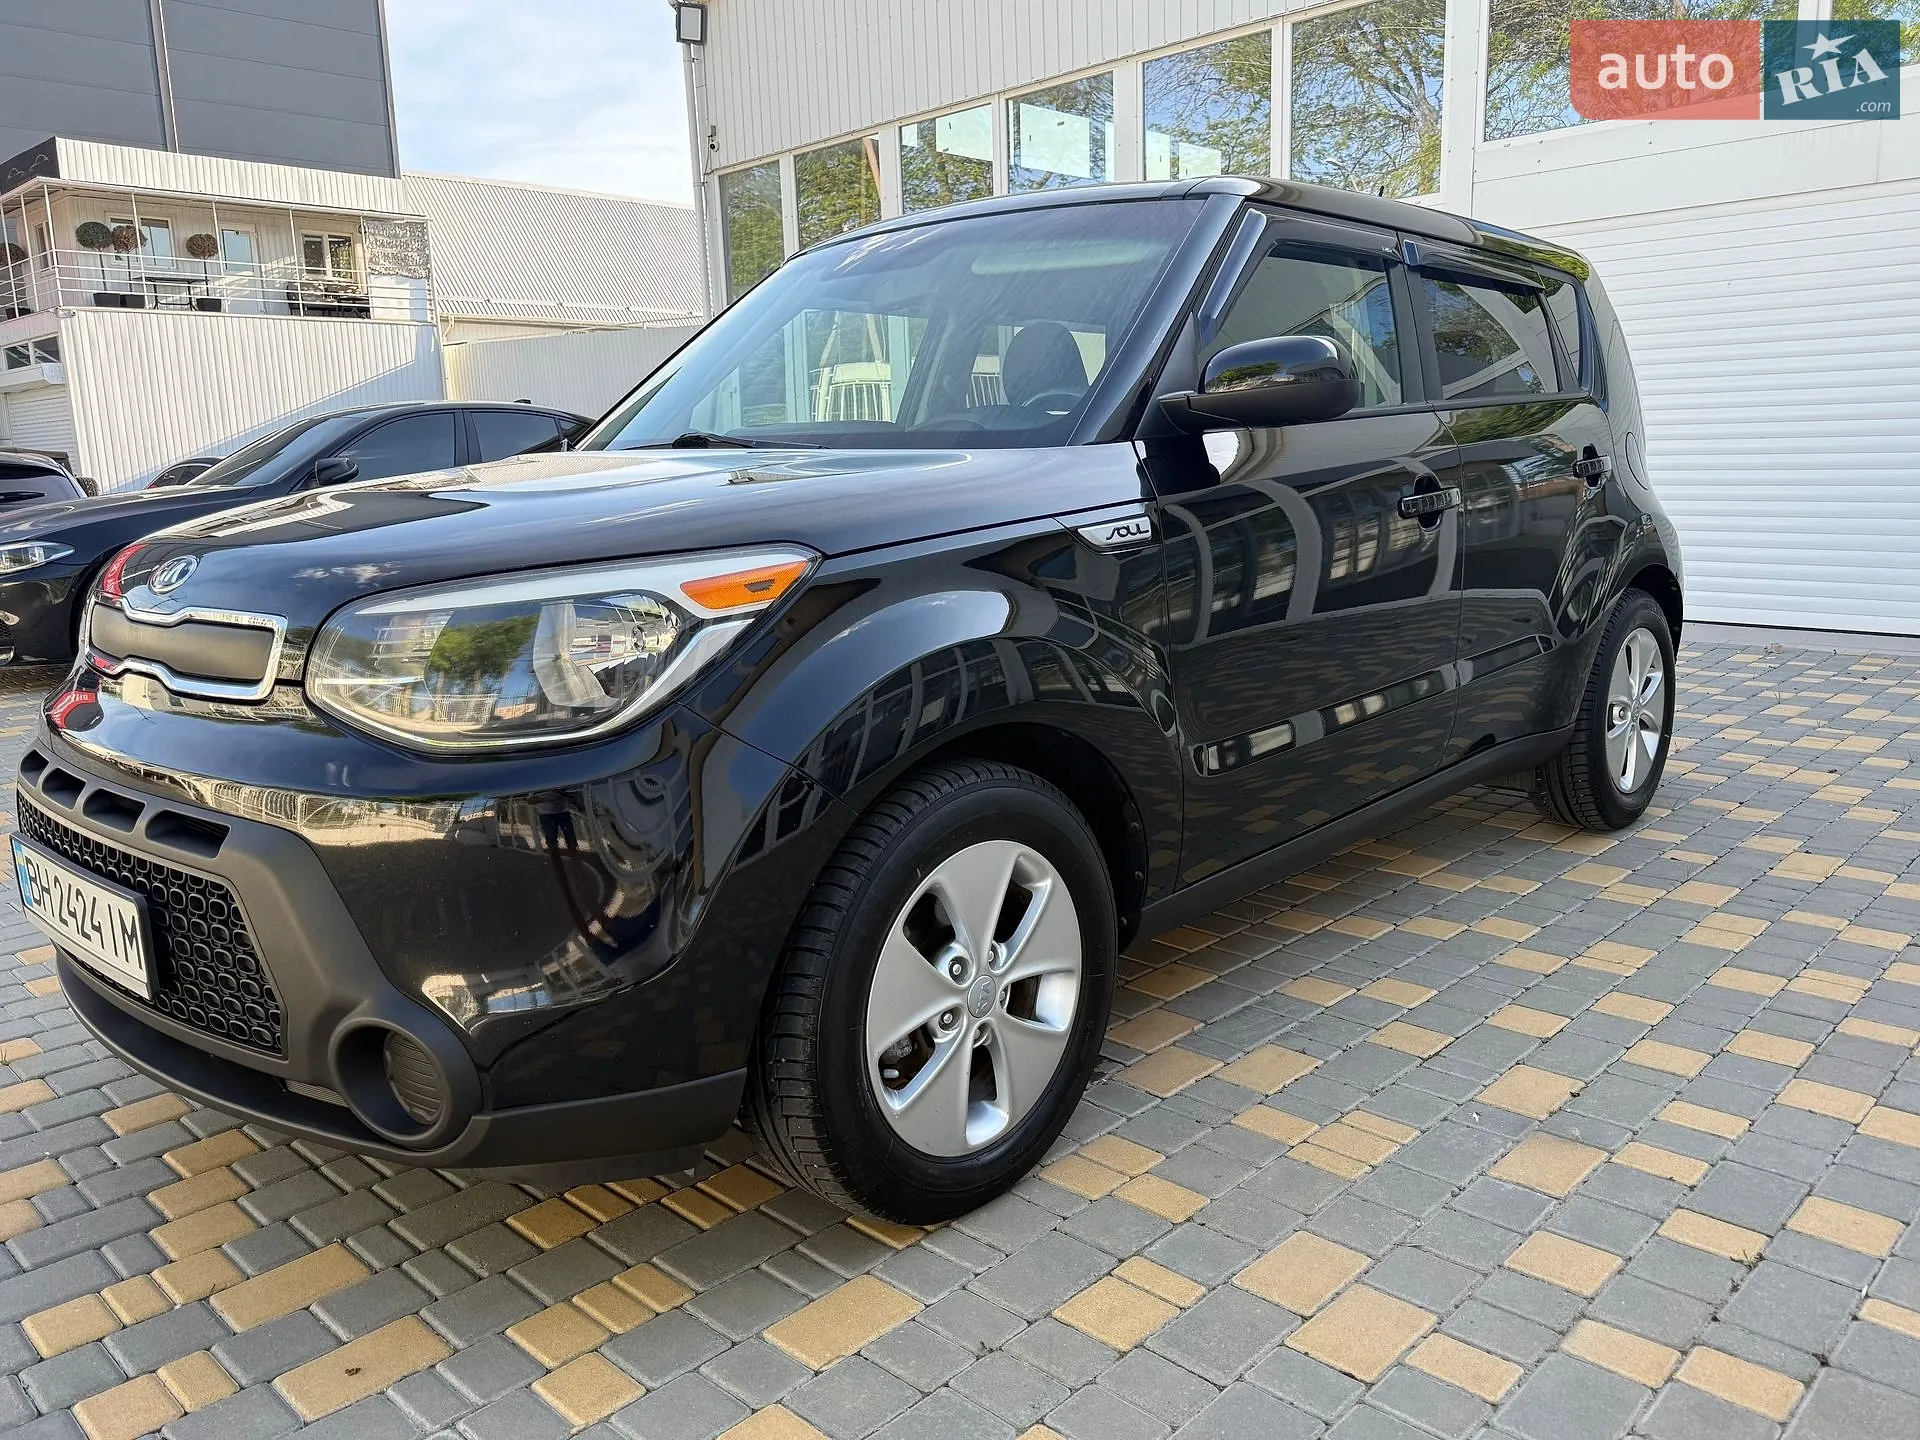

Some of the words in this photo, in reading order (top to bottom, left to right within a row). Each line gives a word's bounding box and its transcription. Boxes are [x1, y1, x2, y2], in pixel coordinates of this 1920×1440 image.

[25, 855, 55, 918] BH
[53, 875, 105, 949] 2424
[108, 903, 143, 969] IM
